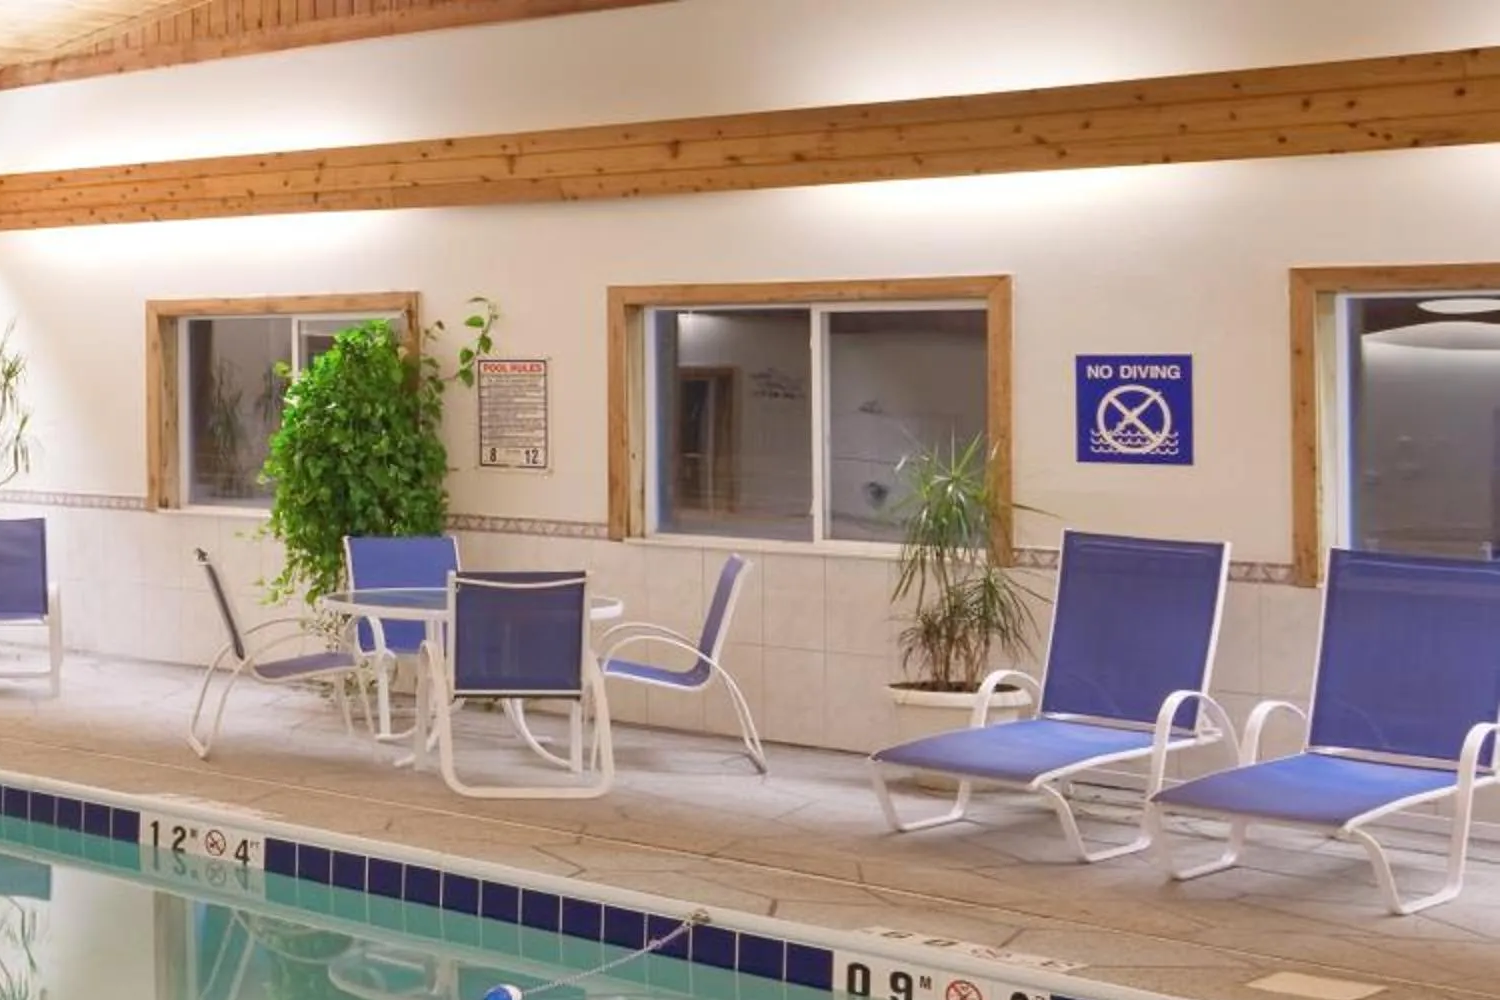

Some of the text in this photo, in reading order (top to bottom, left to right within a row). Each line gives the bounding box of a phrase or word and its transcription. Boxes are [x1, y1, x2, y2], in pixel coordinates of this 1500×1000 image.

[1086, 364, 1181, 380] NO DIVING
[525, 448, 540, 464] 12
[234, 839, 251, 866] 4
